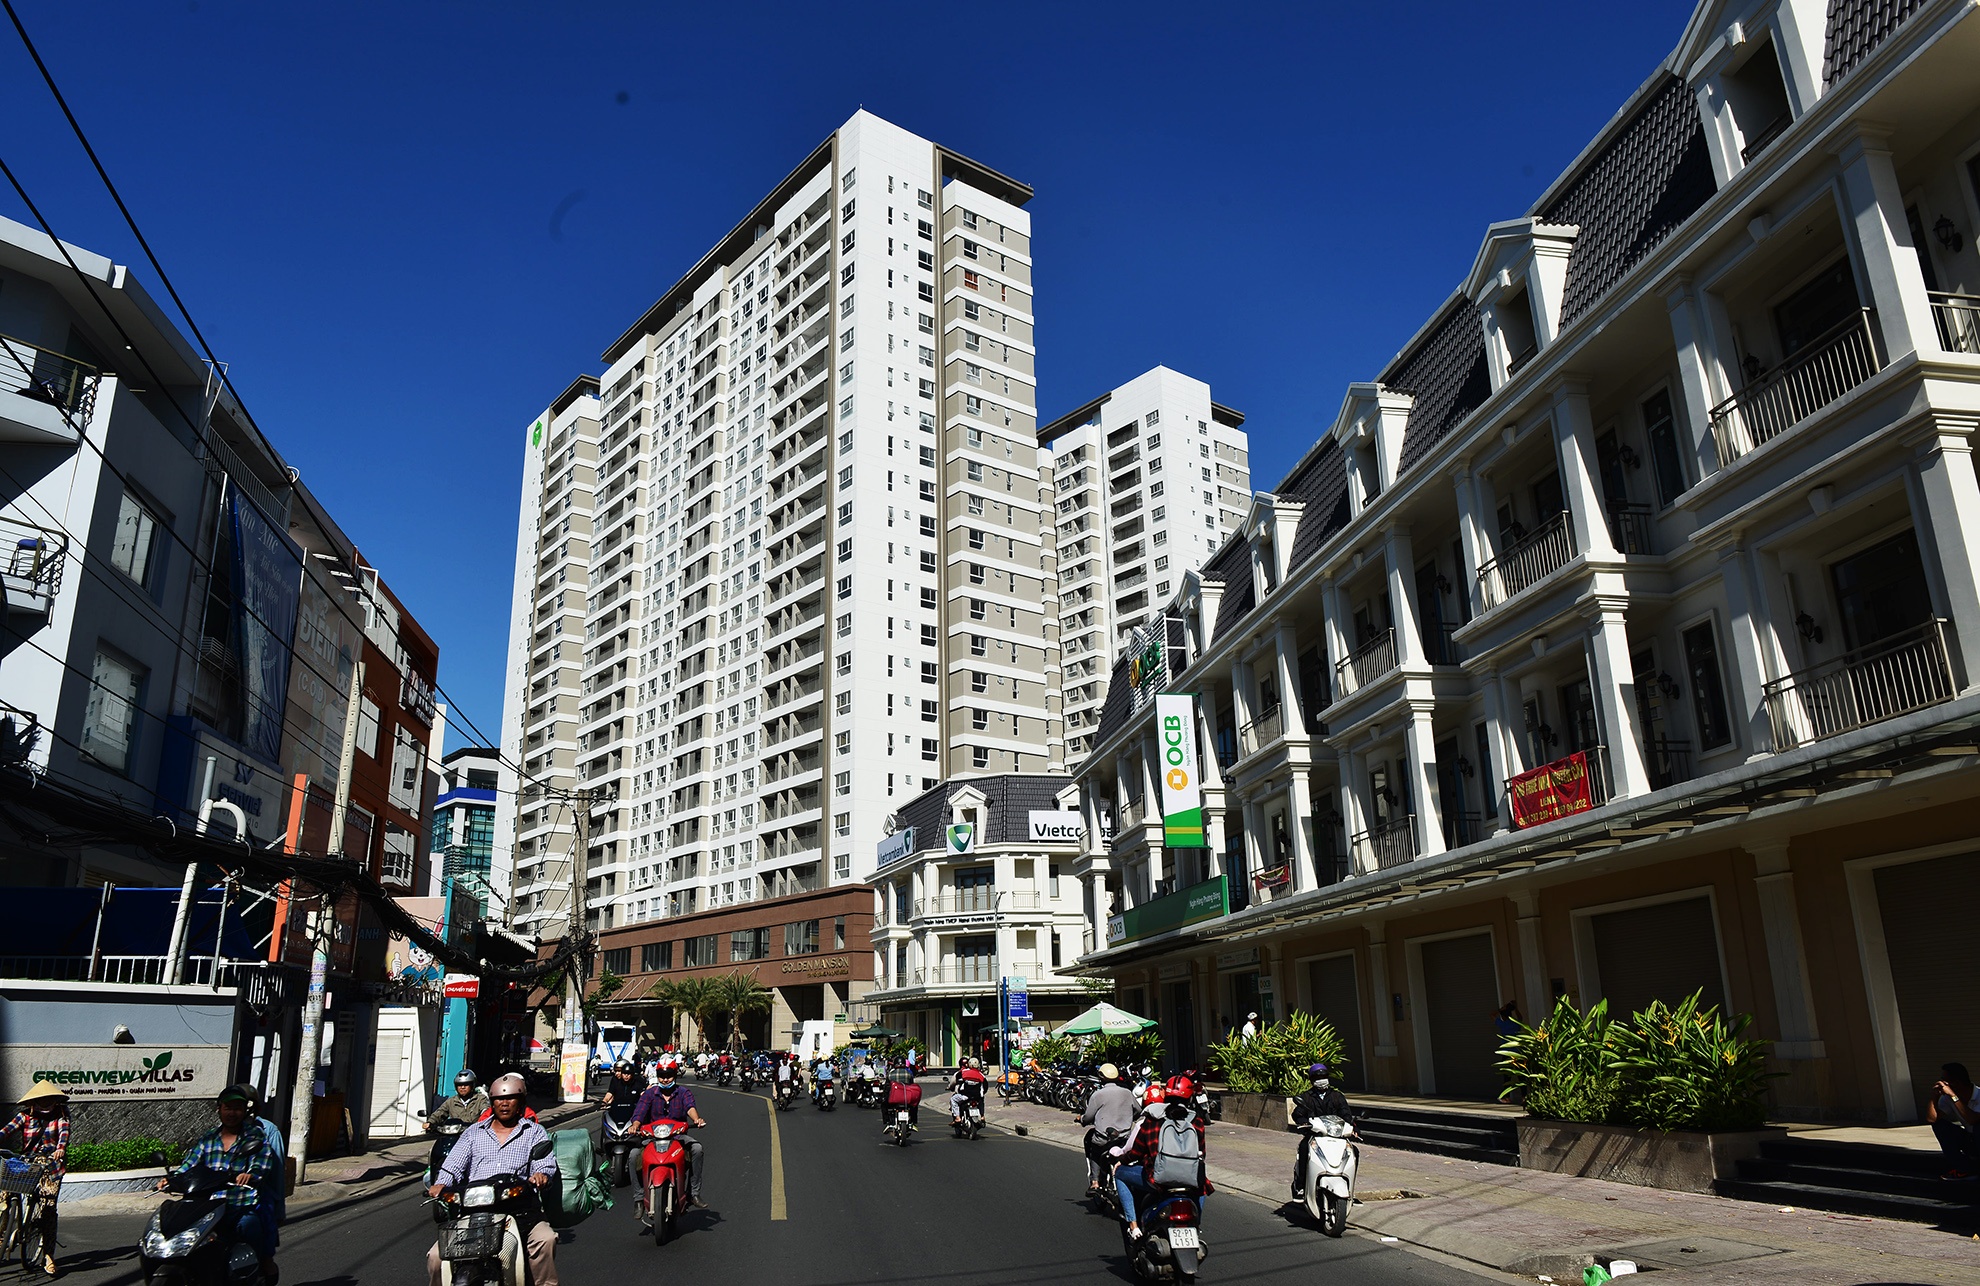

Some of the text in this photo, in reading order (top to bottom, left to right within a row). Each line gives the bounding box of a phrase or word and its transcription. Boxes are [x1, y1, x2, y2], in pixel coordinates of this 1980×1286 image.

[1164, 715, 1184, 766] OCB
[1114, 921, 1123, 935] OCB
[781, 956, 849, 974] GOLDEN MANSION
[32, 1069, 195, 1085] GREENVIEW VILLAS
[1172, 1229, 1193, 1237] 52-P1
[1174, 1238, 1195, 1247] 4151
